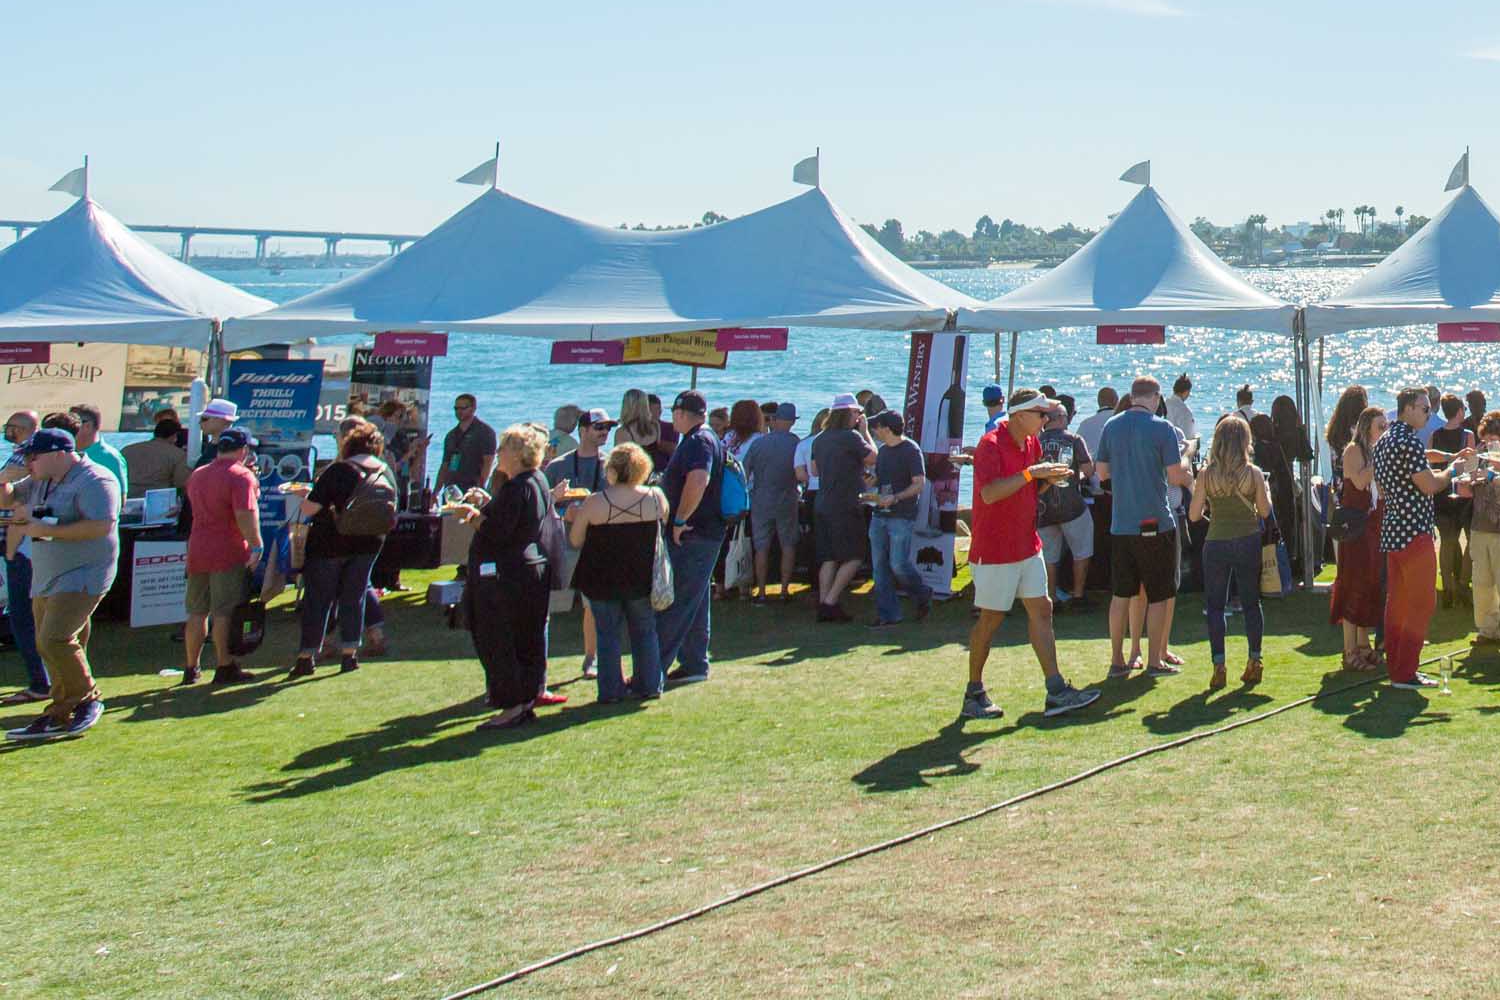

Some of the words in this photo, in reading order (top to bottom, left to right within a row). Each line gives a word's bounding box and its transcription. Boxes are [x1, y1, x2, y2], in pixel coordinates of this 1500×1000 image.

[6, 362, 103, 384] FLAGSHIP
[232, 372, 315, 386] Patriot
[906, 340, 925, 408] WINERY
[252, 388, 295, 398] THRILL!
[249, 399, 293, 408] POWER!
